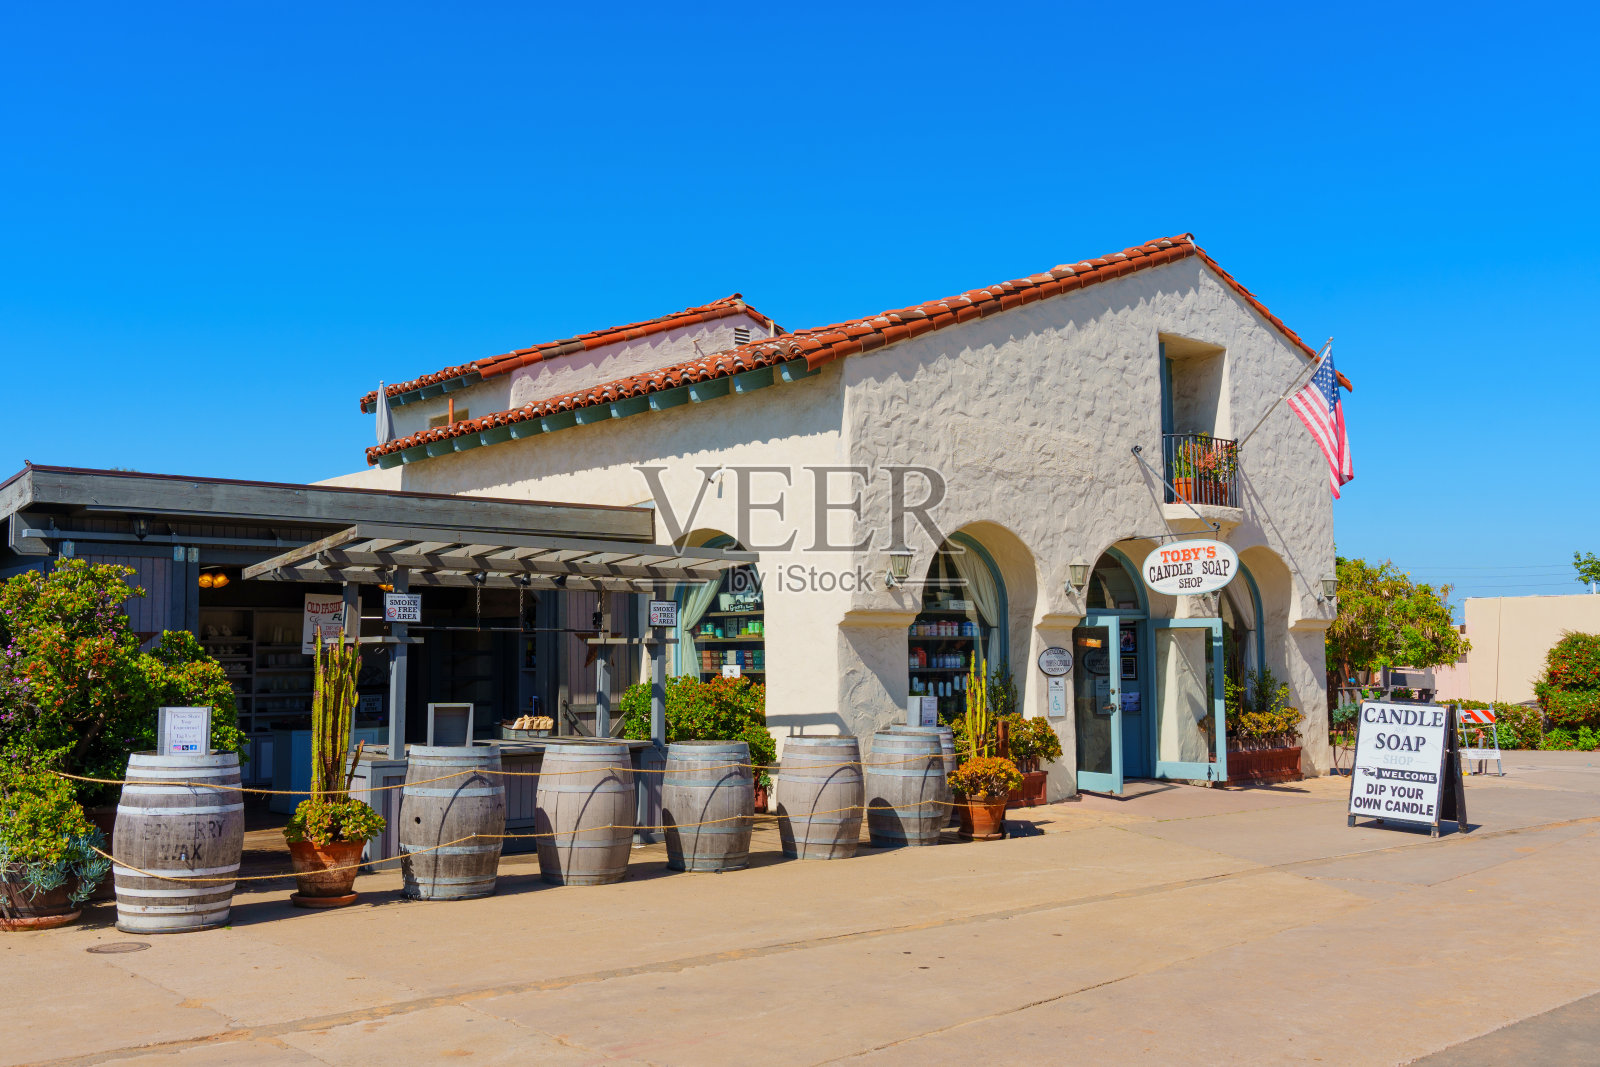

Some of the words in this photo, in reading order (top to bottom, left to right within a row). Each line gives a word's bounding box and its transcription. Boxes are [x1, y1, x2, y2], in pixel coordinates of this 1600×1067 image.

[1160, 546, 1216, 563] TOBY'S
[1149, 562, 1193, 583] CANDLE
[1202, 559, 1230, 576] SOAP
[1178, 577, 1203, 588] SHOP
[307, 601, 320, 613] OLD
[1046, 649, 1066, 657] WELCOME
[1364, 707, 1444, 727] CANDLE
[1375, 732, 1426, 752] SOAP
[1383, 754, 1414, 766] SHOP
[1381, 770, 1435, 782] WELCOME
[1366, 783, 1386, 796] DIP
[1391, 785, 1424, 801] YOUR
[1353, 796, 1382, 811] OWN
[1385, 799, 1435, 817] CANDLE
